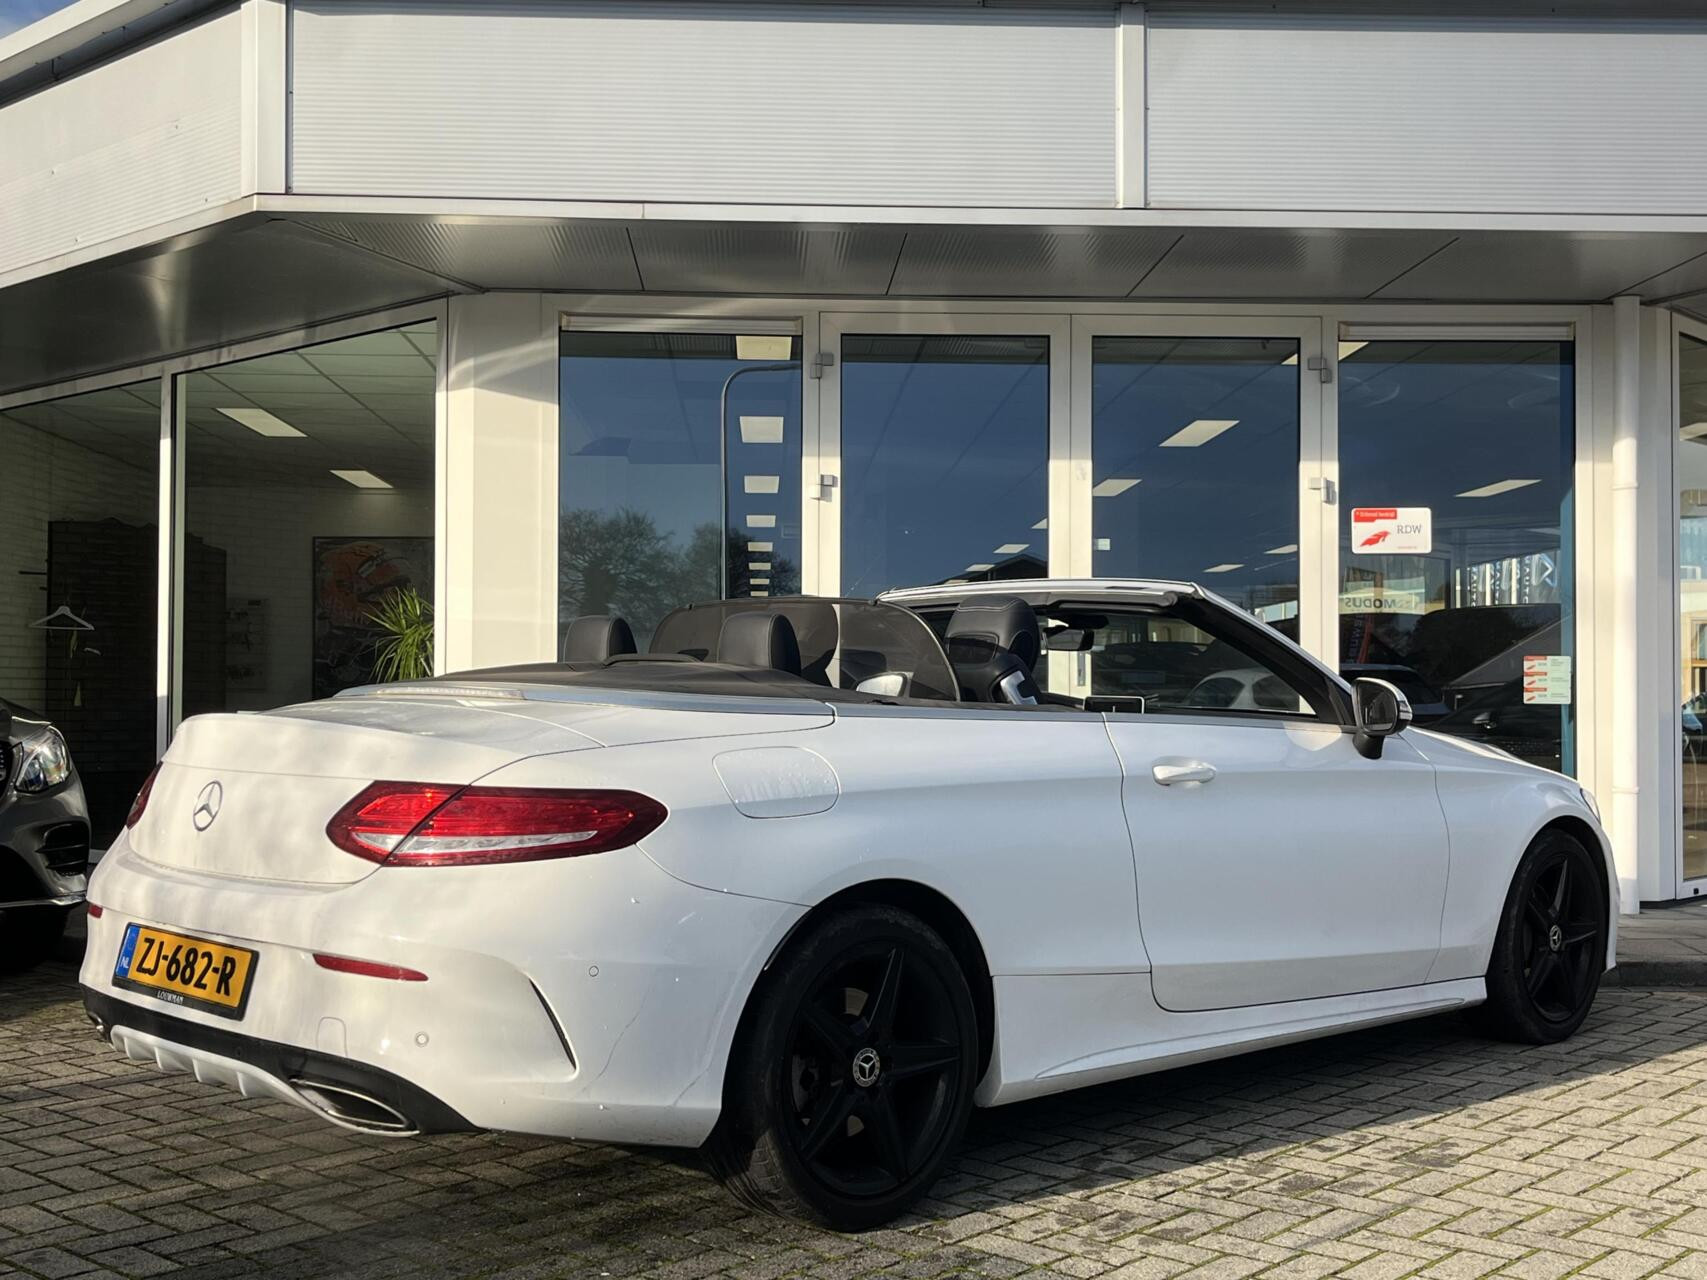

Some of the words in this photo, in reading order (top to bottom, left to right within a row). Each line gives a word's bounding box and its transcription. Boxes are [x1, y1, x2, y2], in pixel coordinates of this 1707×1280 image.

[1397, 524, 1422, 534] RDW
[120, 956, 130, 969] NL
[136, 937, 237, 997] ZJ-682-R
